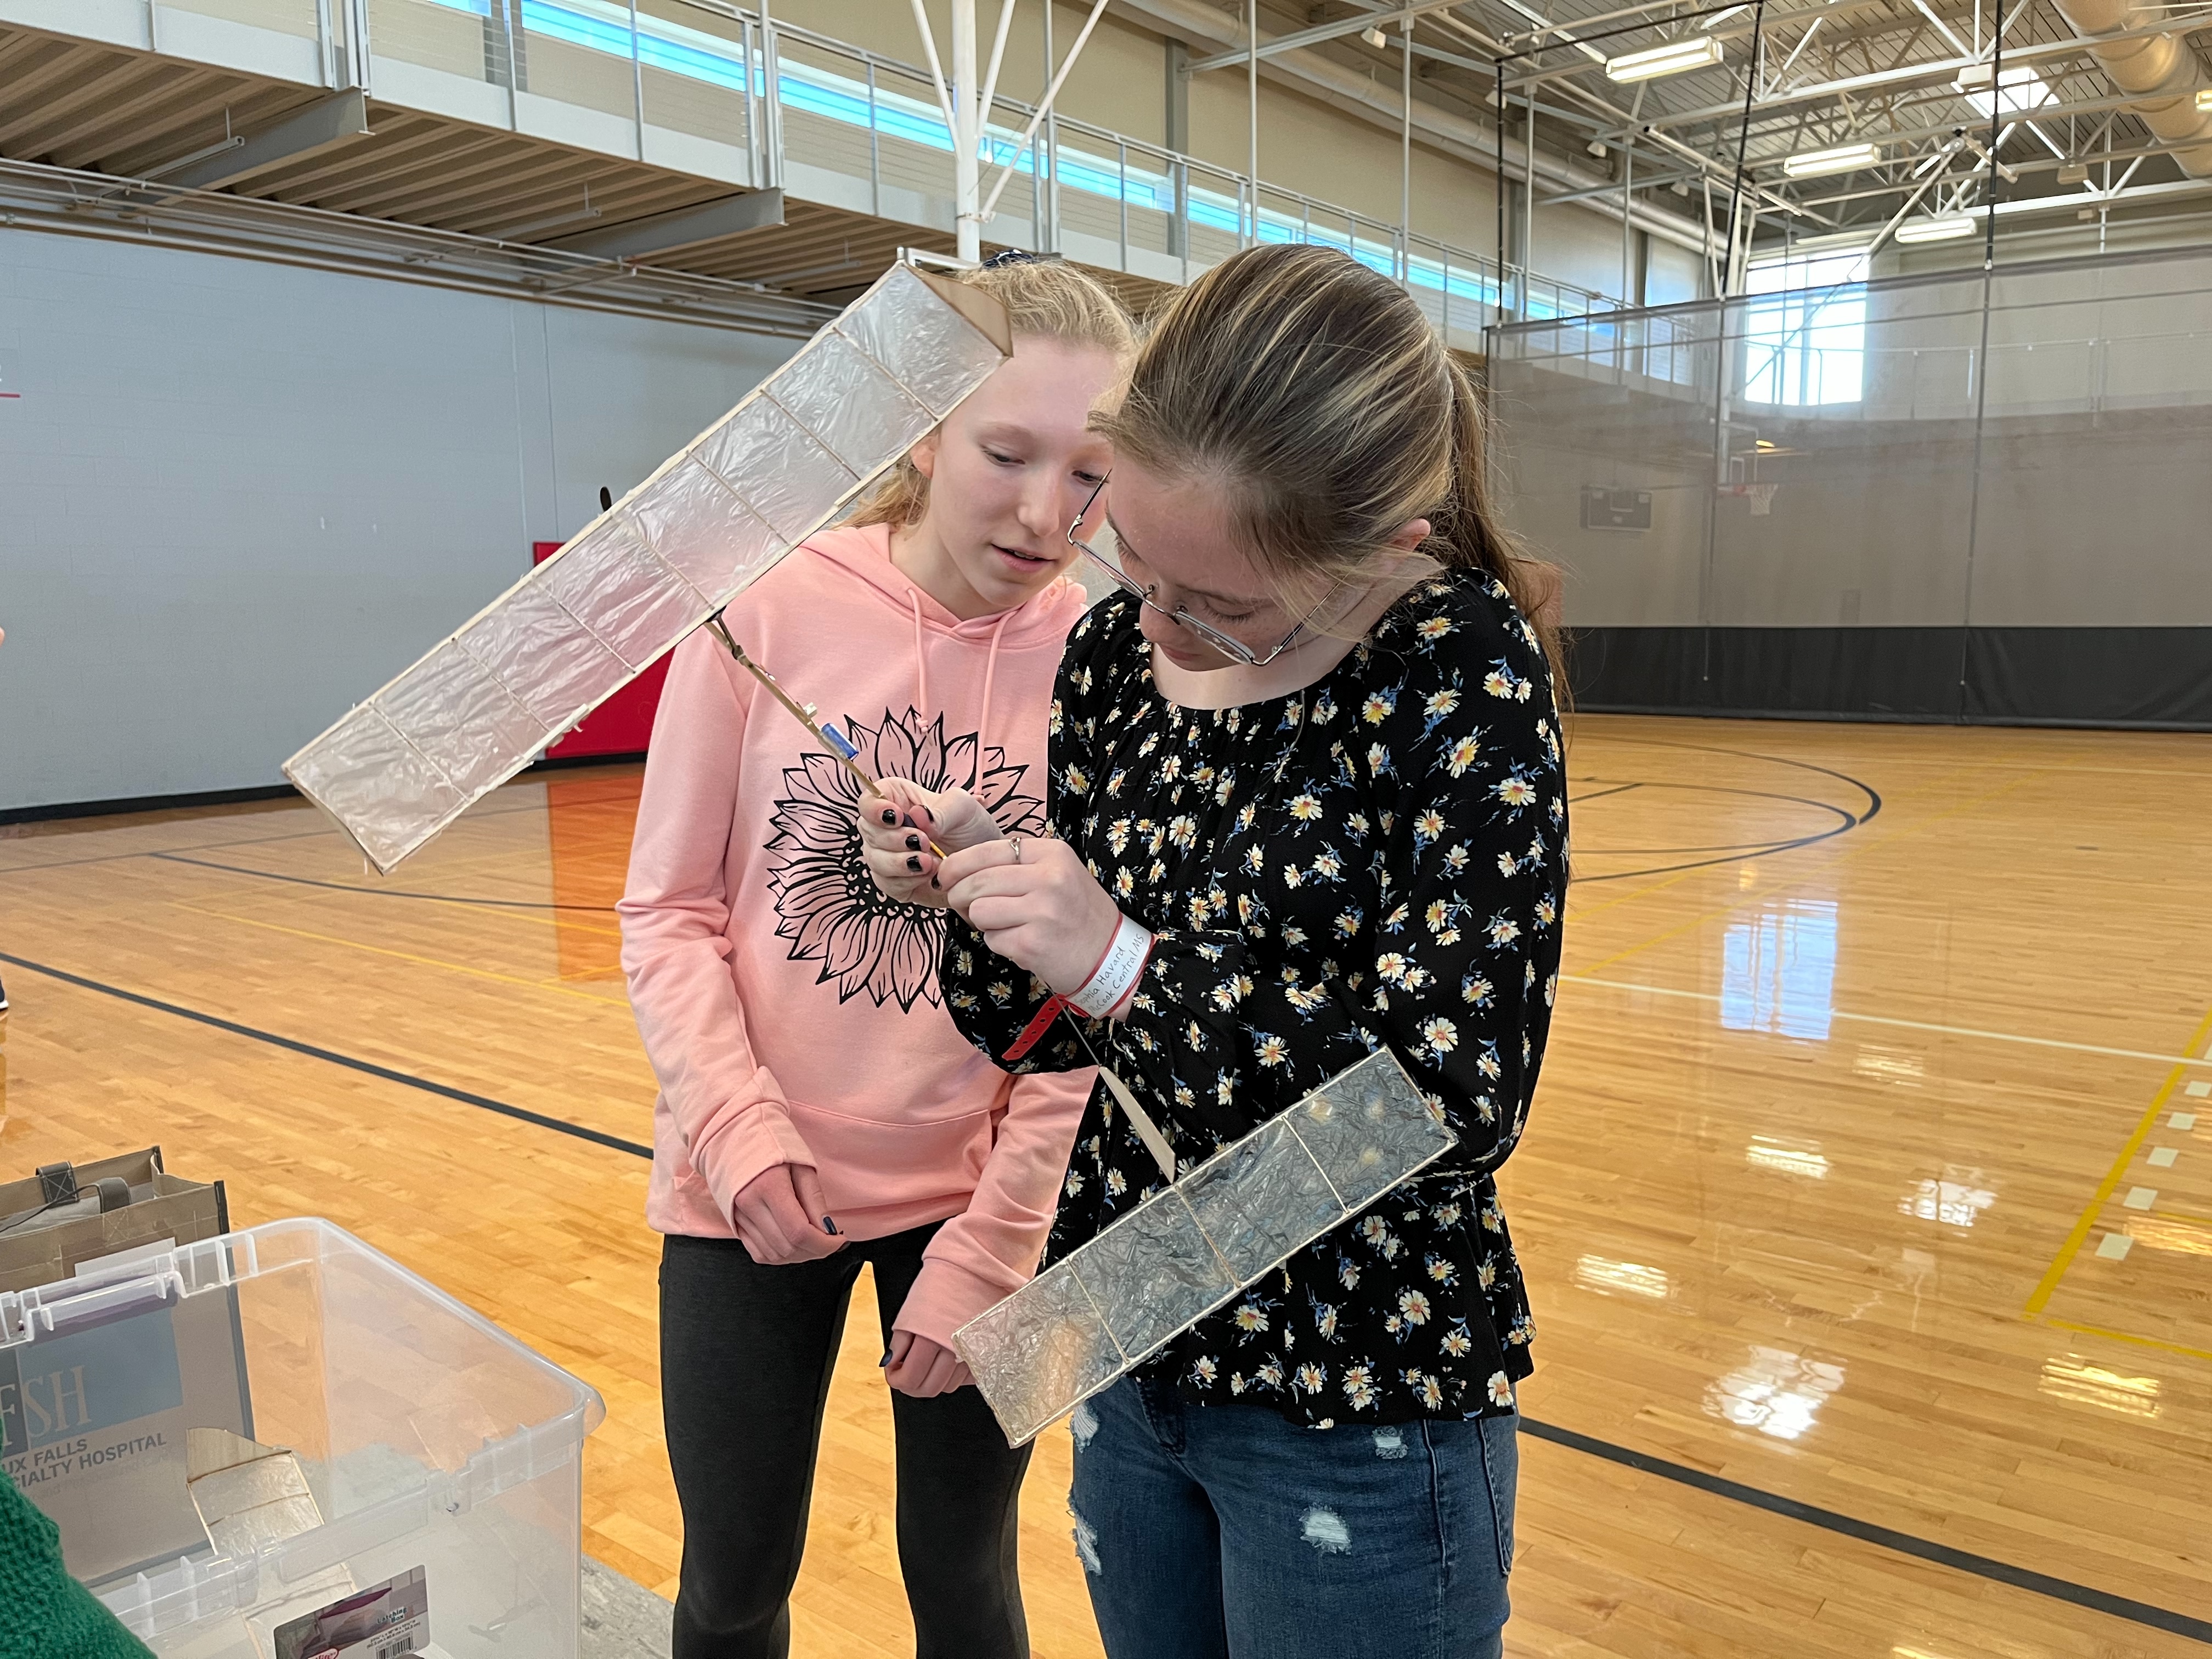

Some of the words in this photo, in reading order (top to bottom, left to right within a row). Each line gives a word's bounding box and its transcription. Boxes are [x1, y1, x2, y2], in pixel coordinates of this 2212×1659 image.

[1074, 988, 1100, 1006] Sophia
[1096, 945, 1125, 985] Havard
[1113, 950, 1138, 989] Central
[1132, 934, 1144, 952] MS
[34, 1438, 87, 1466] FALLS
[79, 1433, 167, 1470] HOSPITAL
